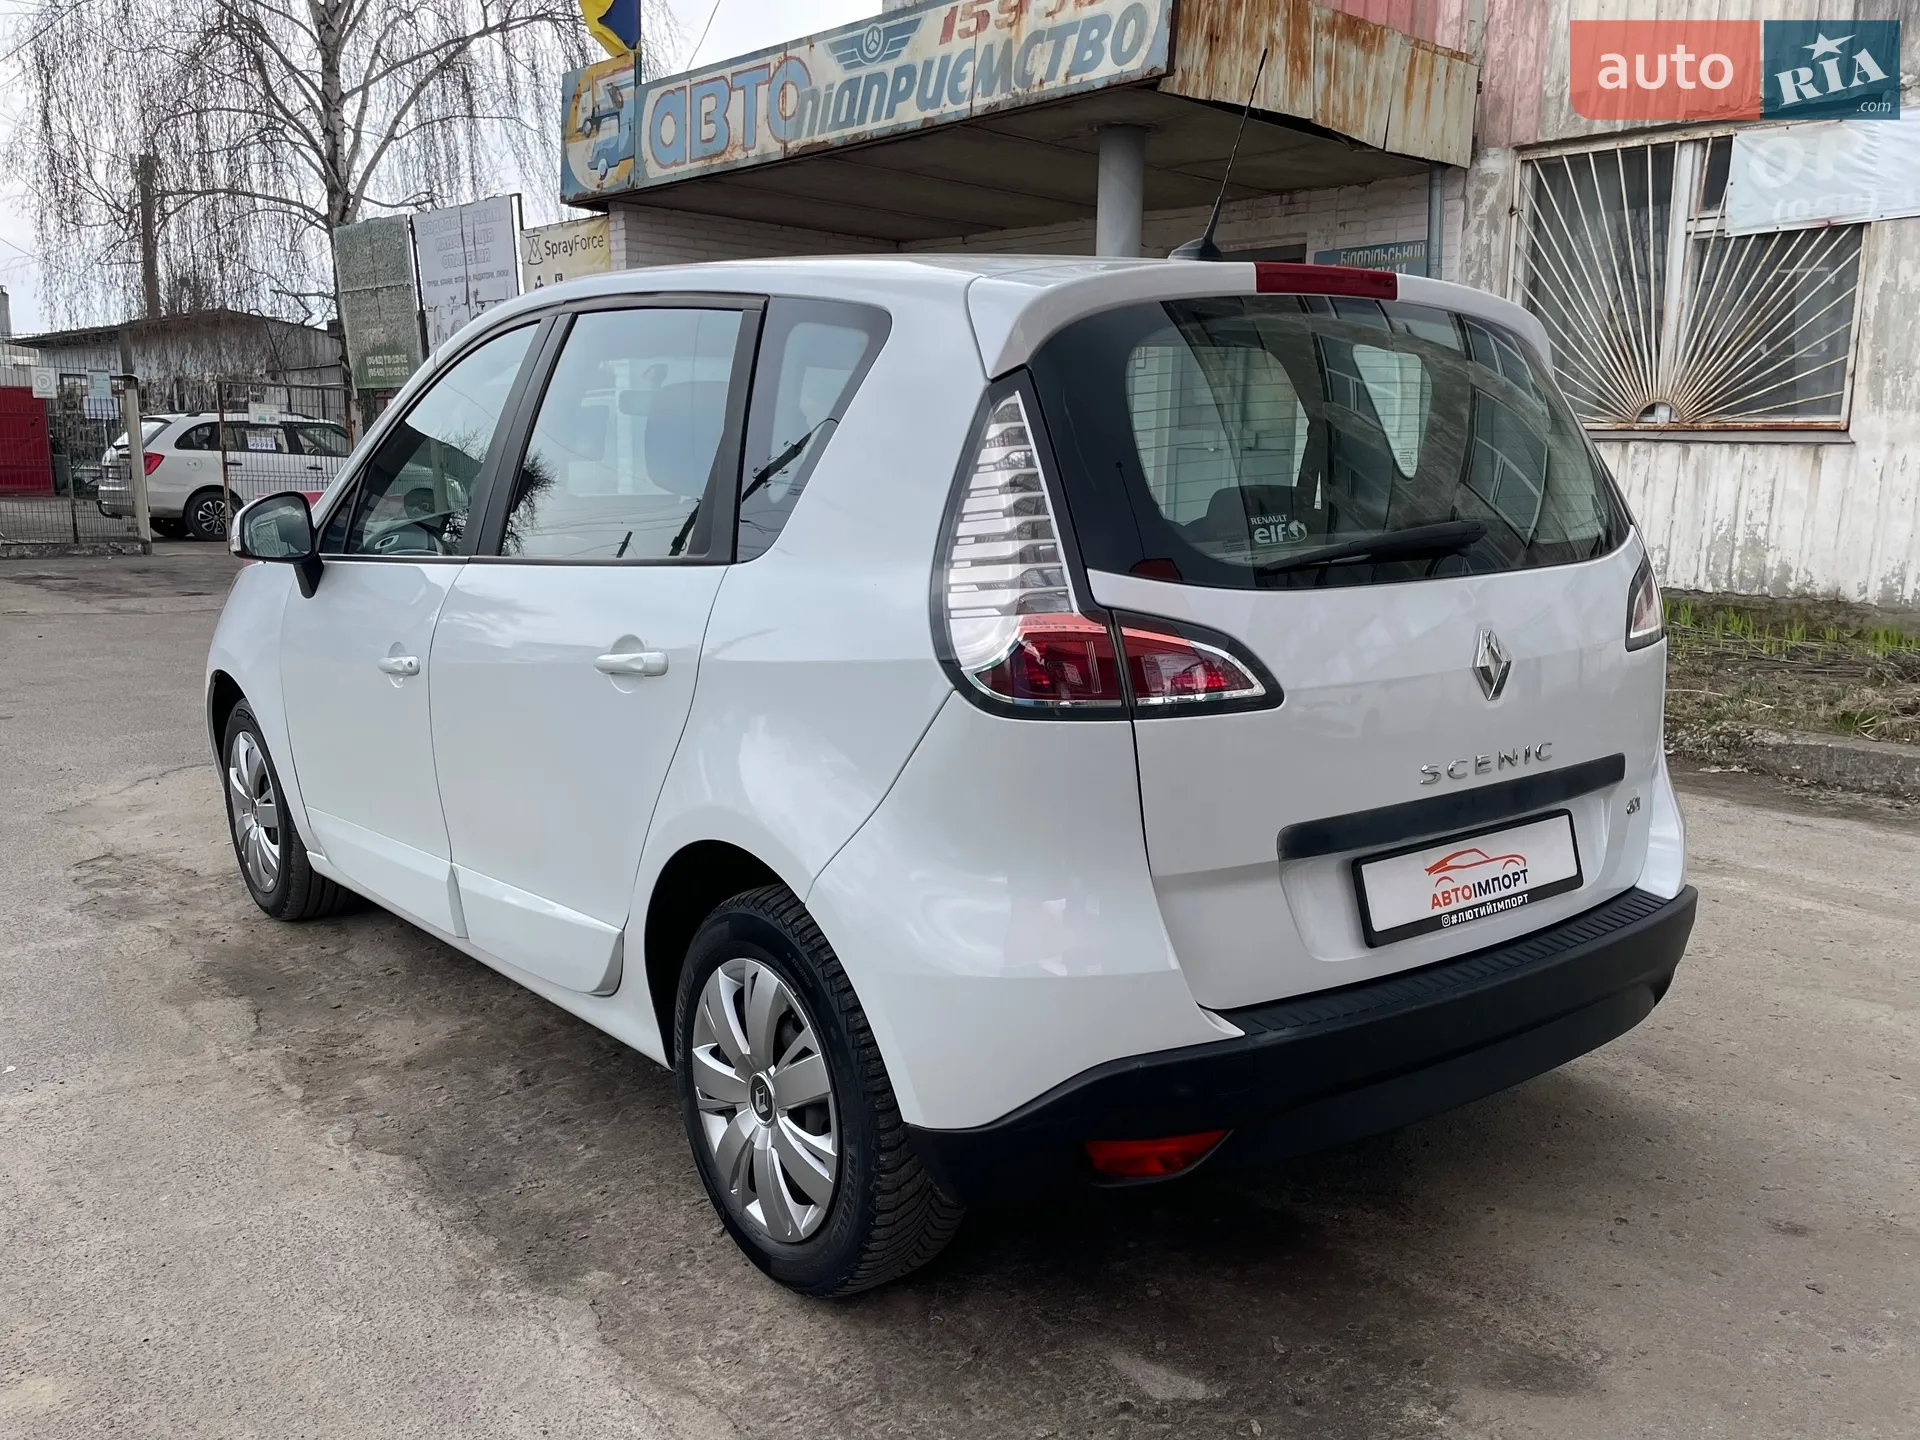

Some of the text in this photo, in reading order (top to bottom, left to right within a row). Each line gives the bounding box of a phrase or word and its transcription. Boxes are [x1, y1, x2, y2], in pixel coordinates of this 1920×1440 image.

[545, 233, 604, 260] SprayForce
[1250, 514, 1287, 525] RENAULT
[1254, 523, 1287, 544] elf
[1419, 741, 1553, 785] SCENIC
[1431, 868, 1528, 910] АВТОІМПОРТ
[1451, 893, 1529, 925] #ЛЮТИЙІМПОРТ
